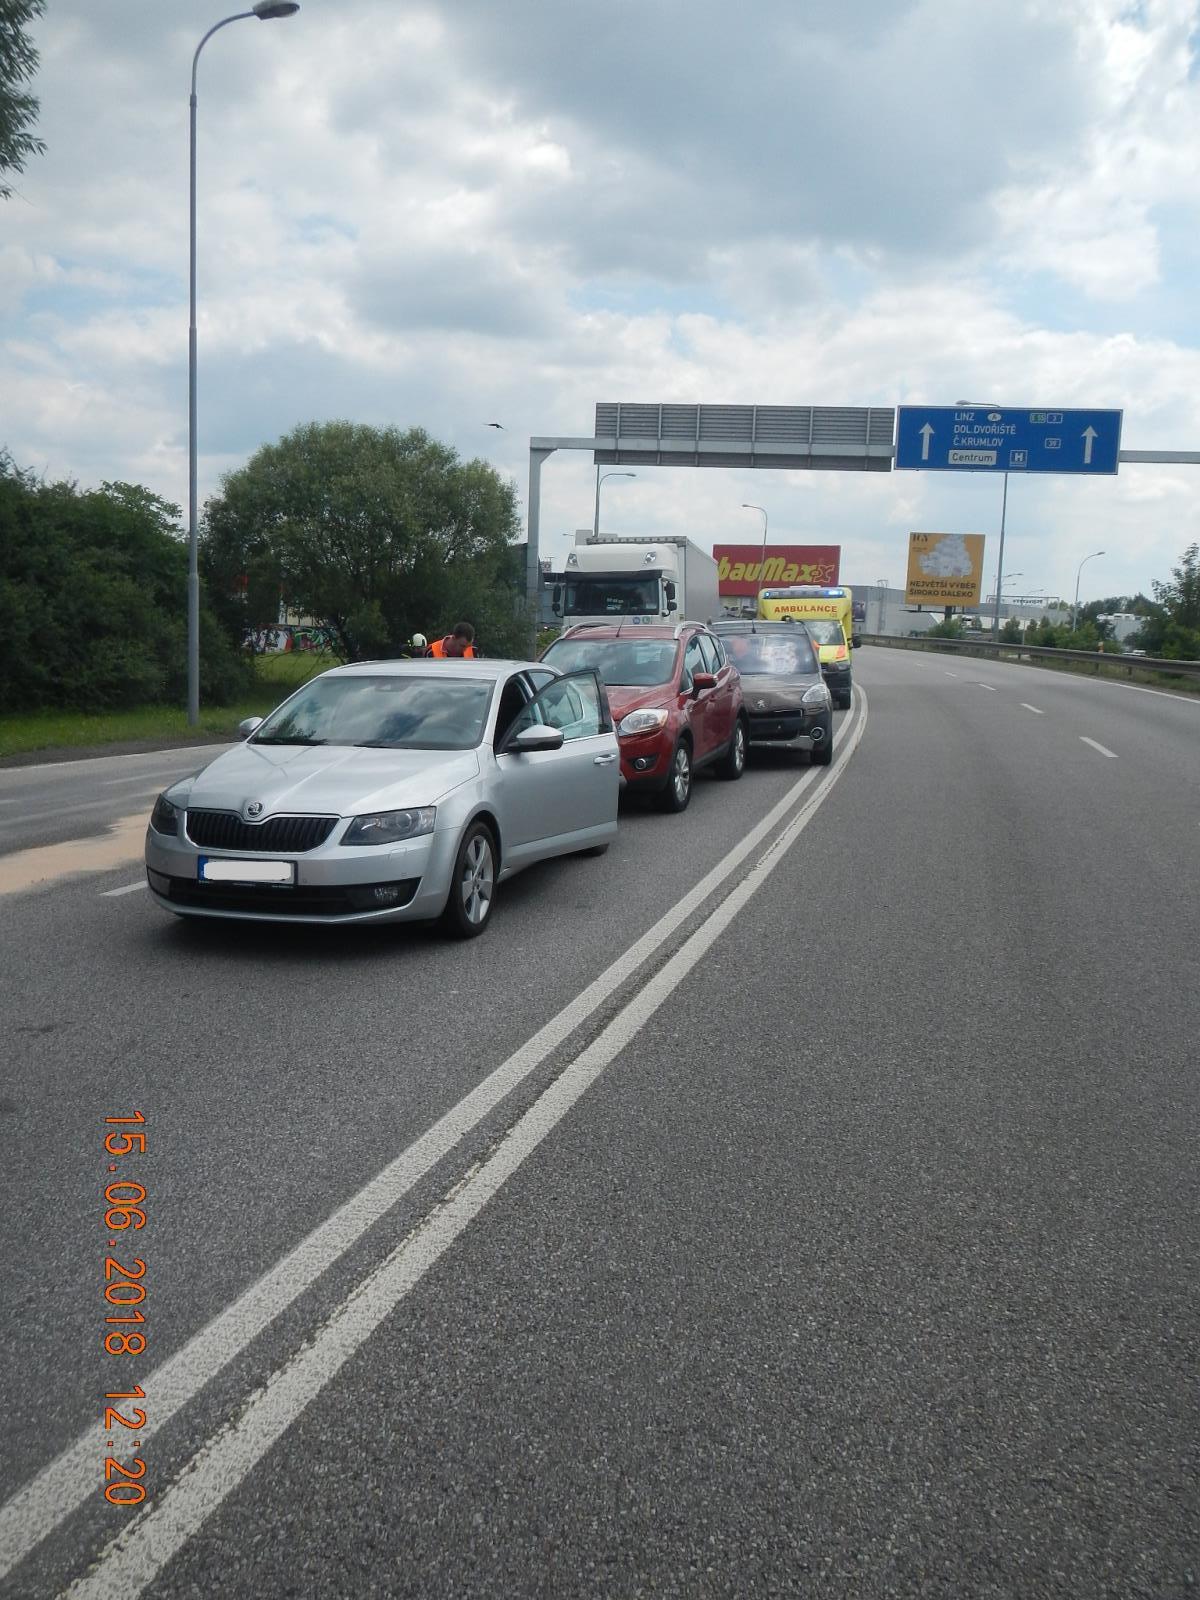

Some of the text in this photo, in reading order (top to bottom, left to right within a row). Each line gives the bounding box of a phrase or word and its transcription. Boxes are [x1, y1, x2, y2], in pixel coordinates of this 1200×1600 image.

[954, 412, 975, 421] LINZ
[953, 435, 1004, 447] Č.KRUMLOV
[952, 452, 993, 462] Centrum
[774, 605, 837, 614] AMBULANCE
